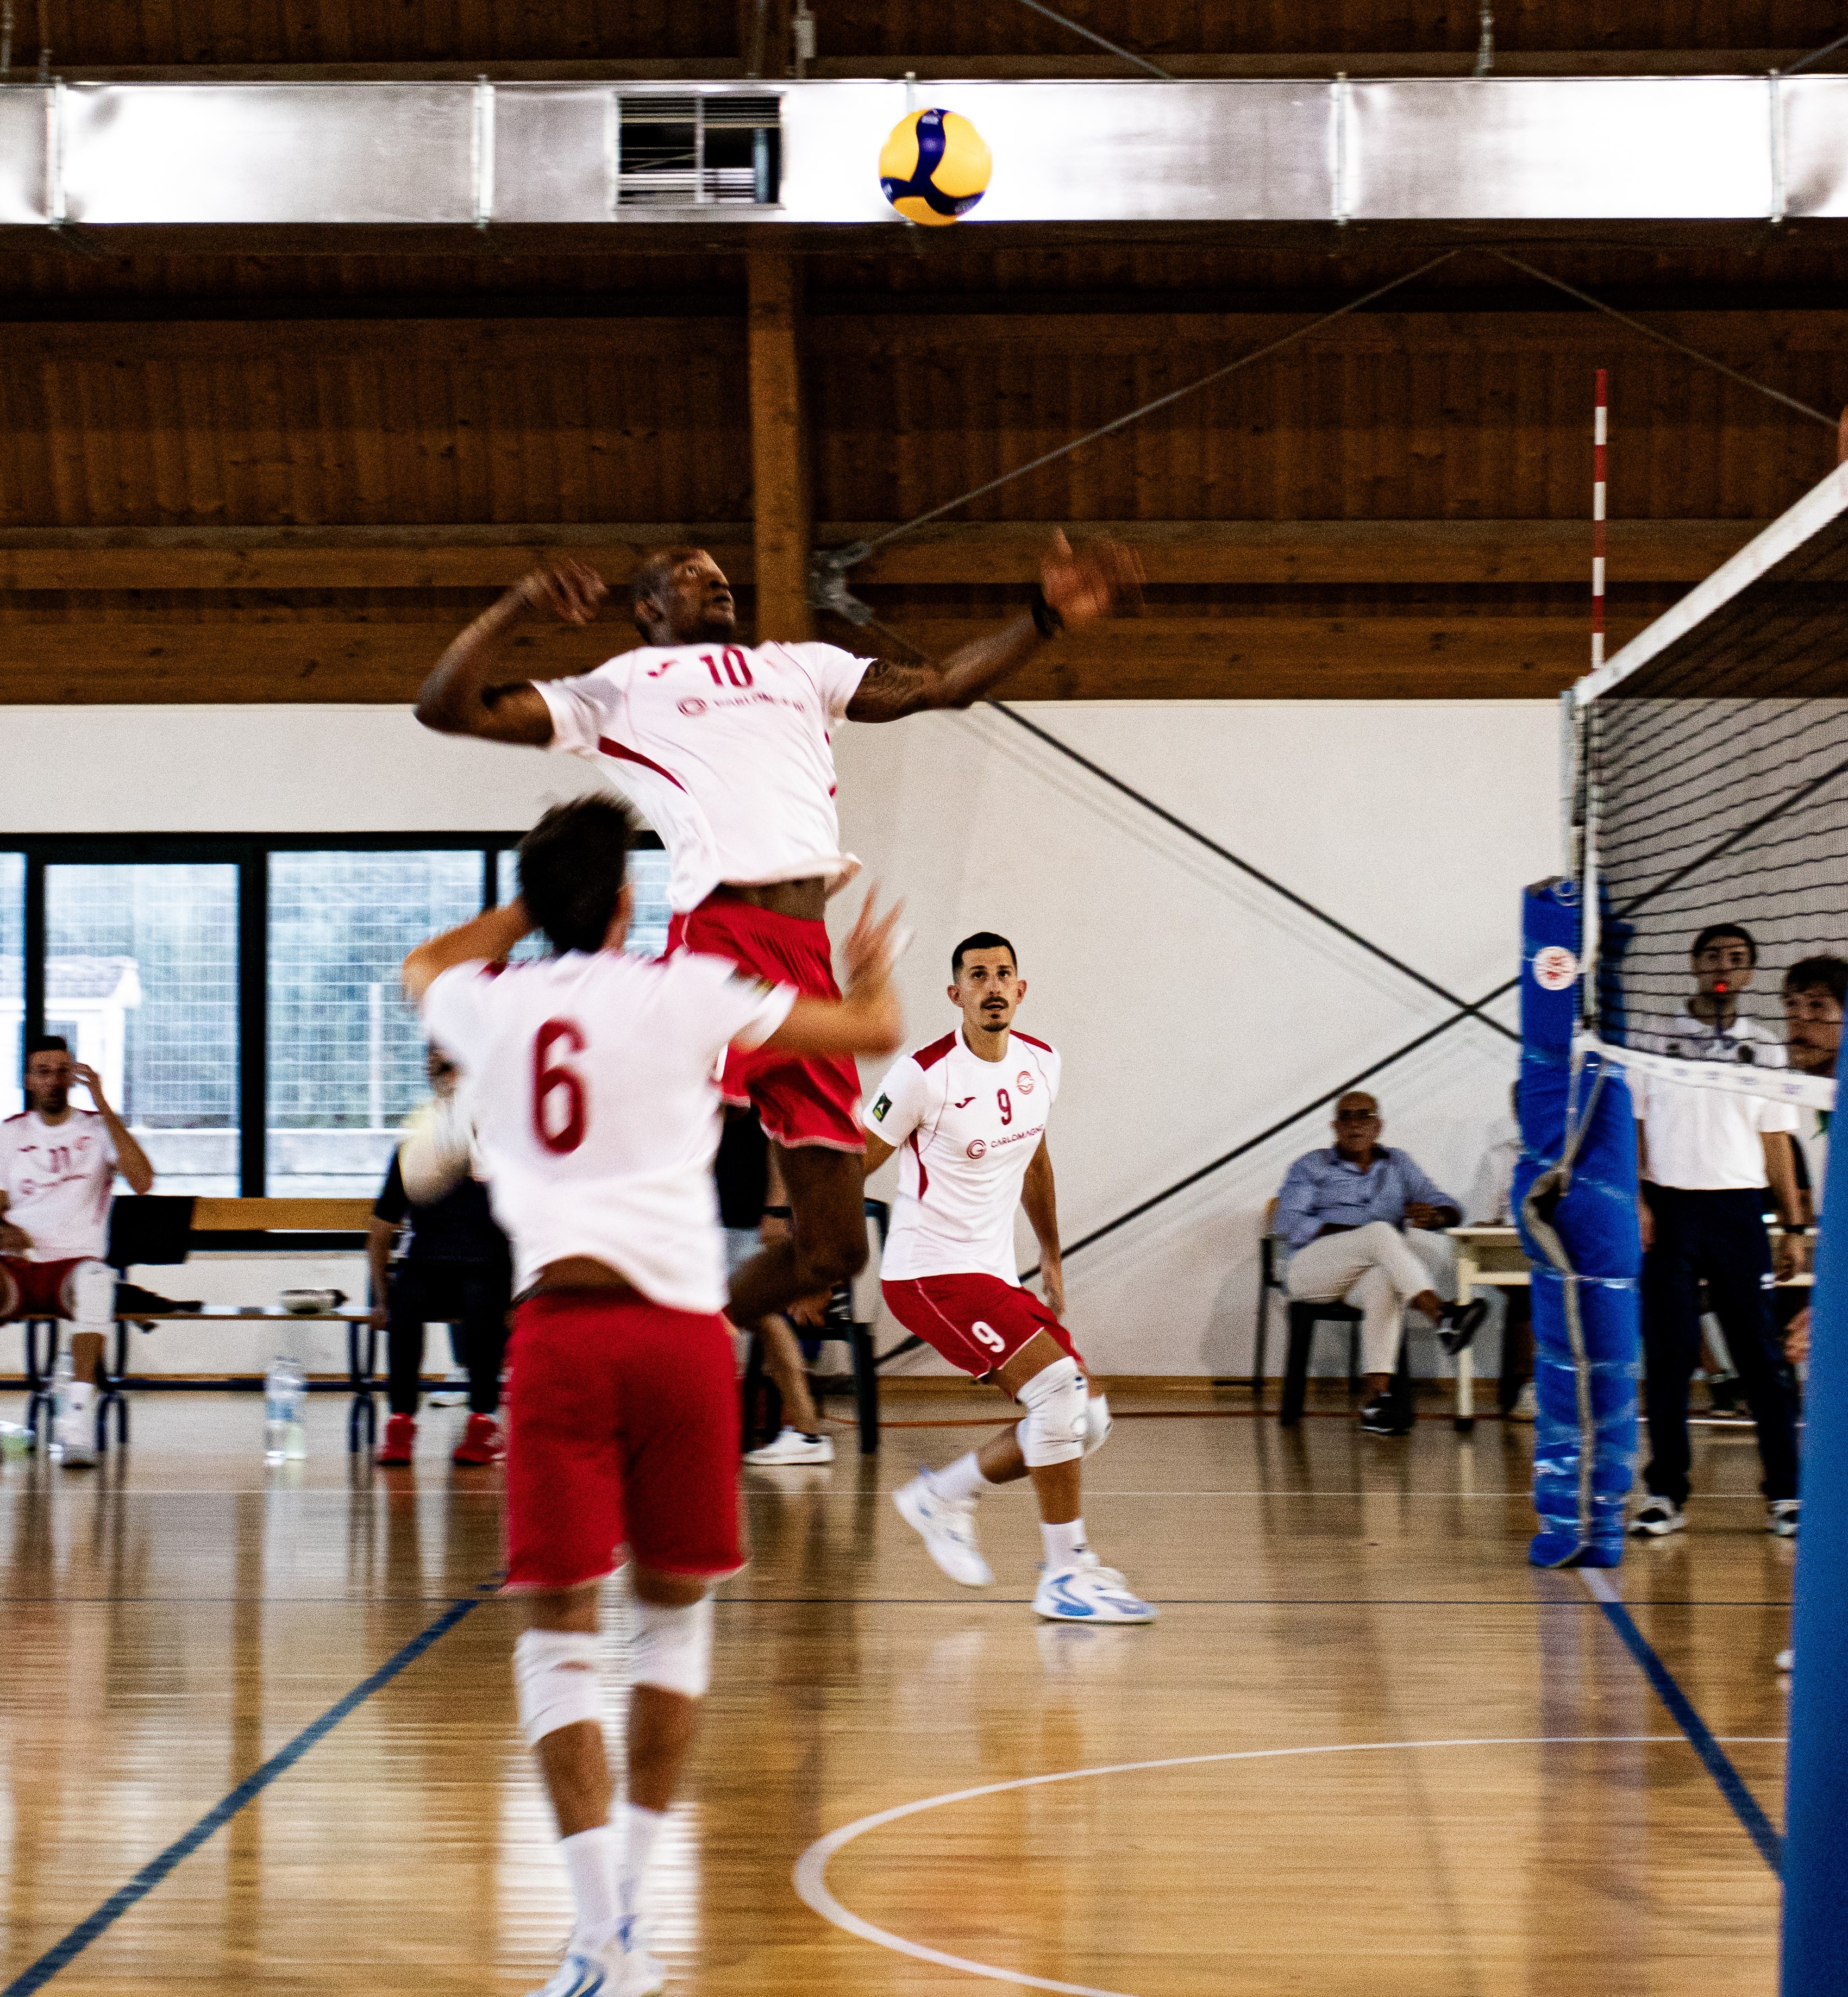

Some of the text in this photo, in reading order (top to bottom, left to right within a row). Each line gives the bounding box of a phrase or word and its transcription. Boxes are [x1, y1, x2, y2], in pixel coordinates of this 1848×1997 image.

[699, 645, 753, 688] 10
[532, 1018, 588, 1156] 6
[997, 1088, 1012, 1125] 9
[972, 1321, 1005, 1353] 9
